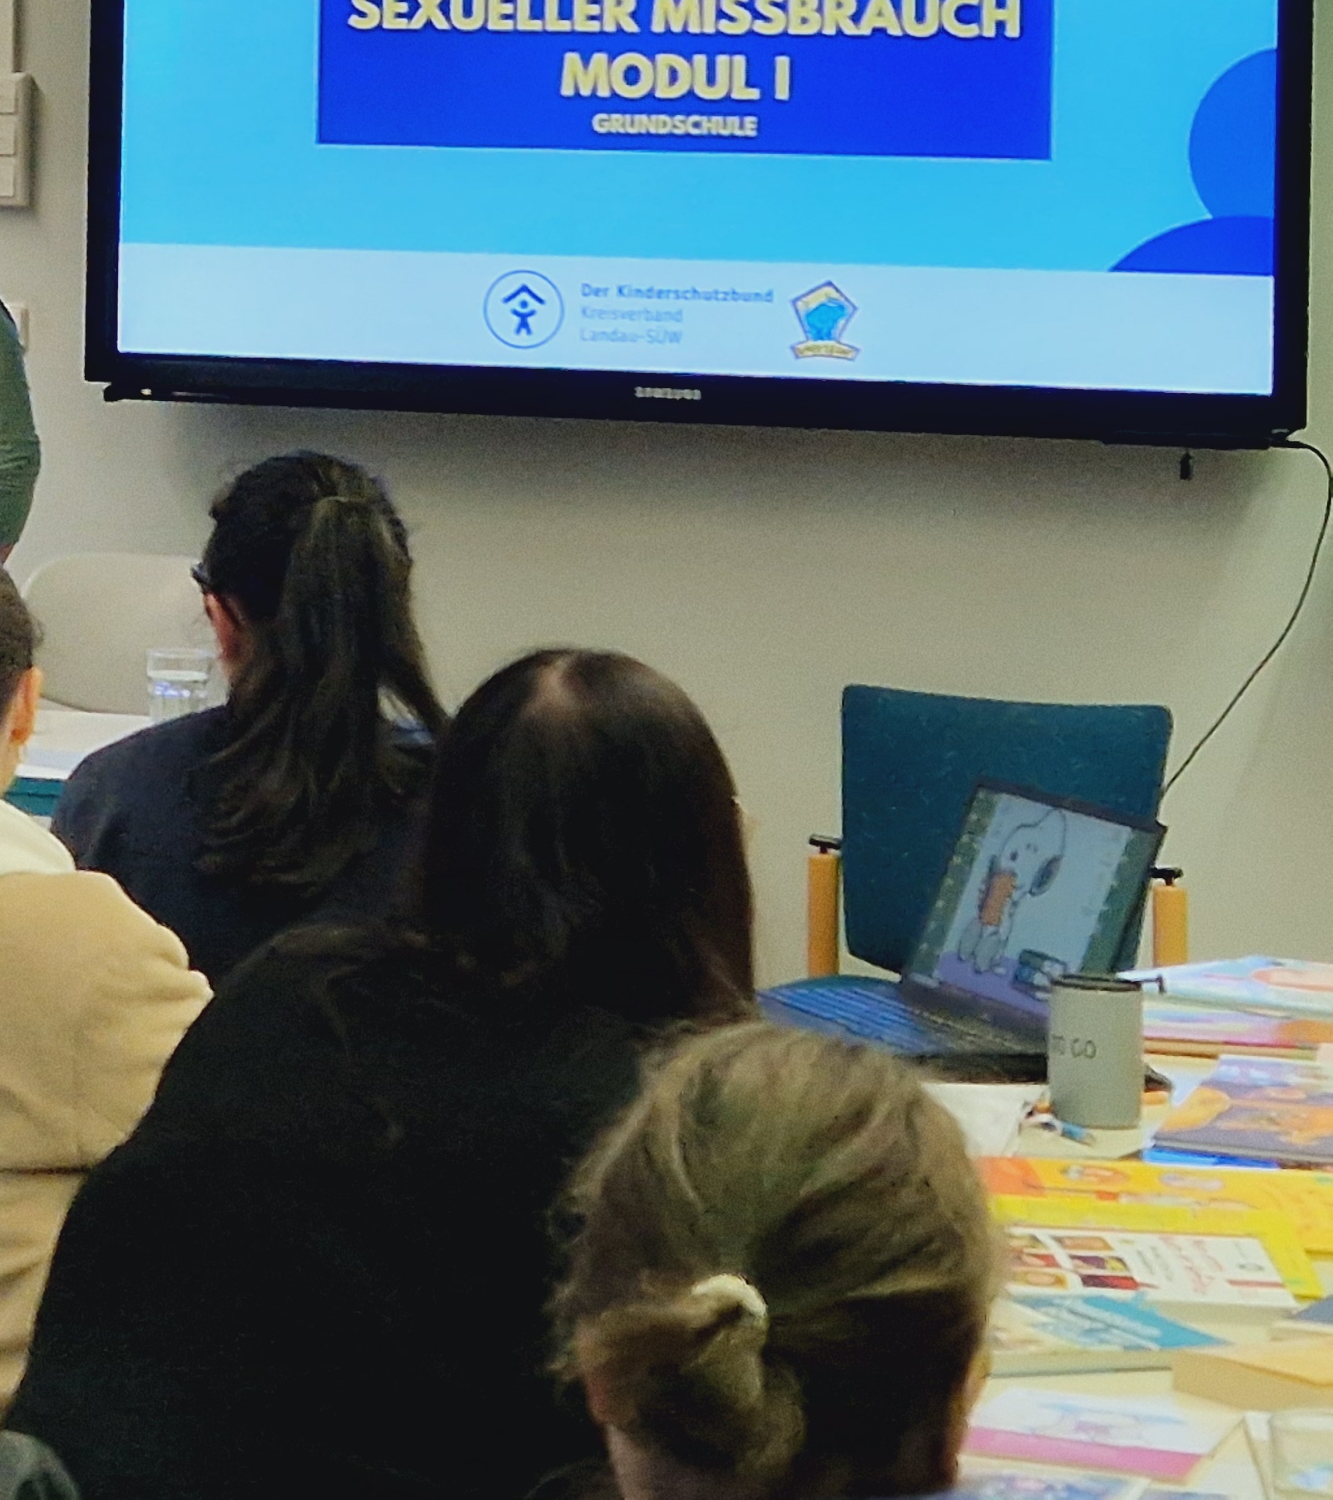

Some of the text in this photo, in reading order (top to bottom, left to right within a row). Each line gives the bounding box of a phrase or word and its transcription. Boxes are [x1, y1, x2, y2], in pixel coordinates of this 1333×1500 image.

[559, 51, 761, 100] MODUL
[591, 112, 759, 137] GRUNDSCHULE
[581, 283, 773, 302] Der Kinderschutzbund
